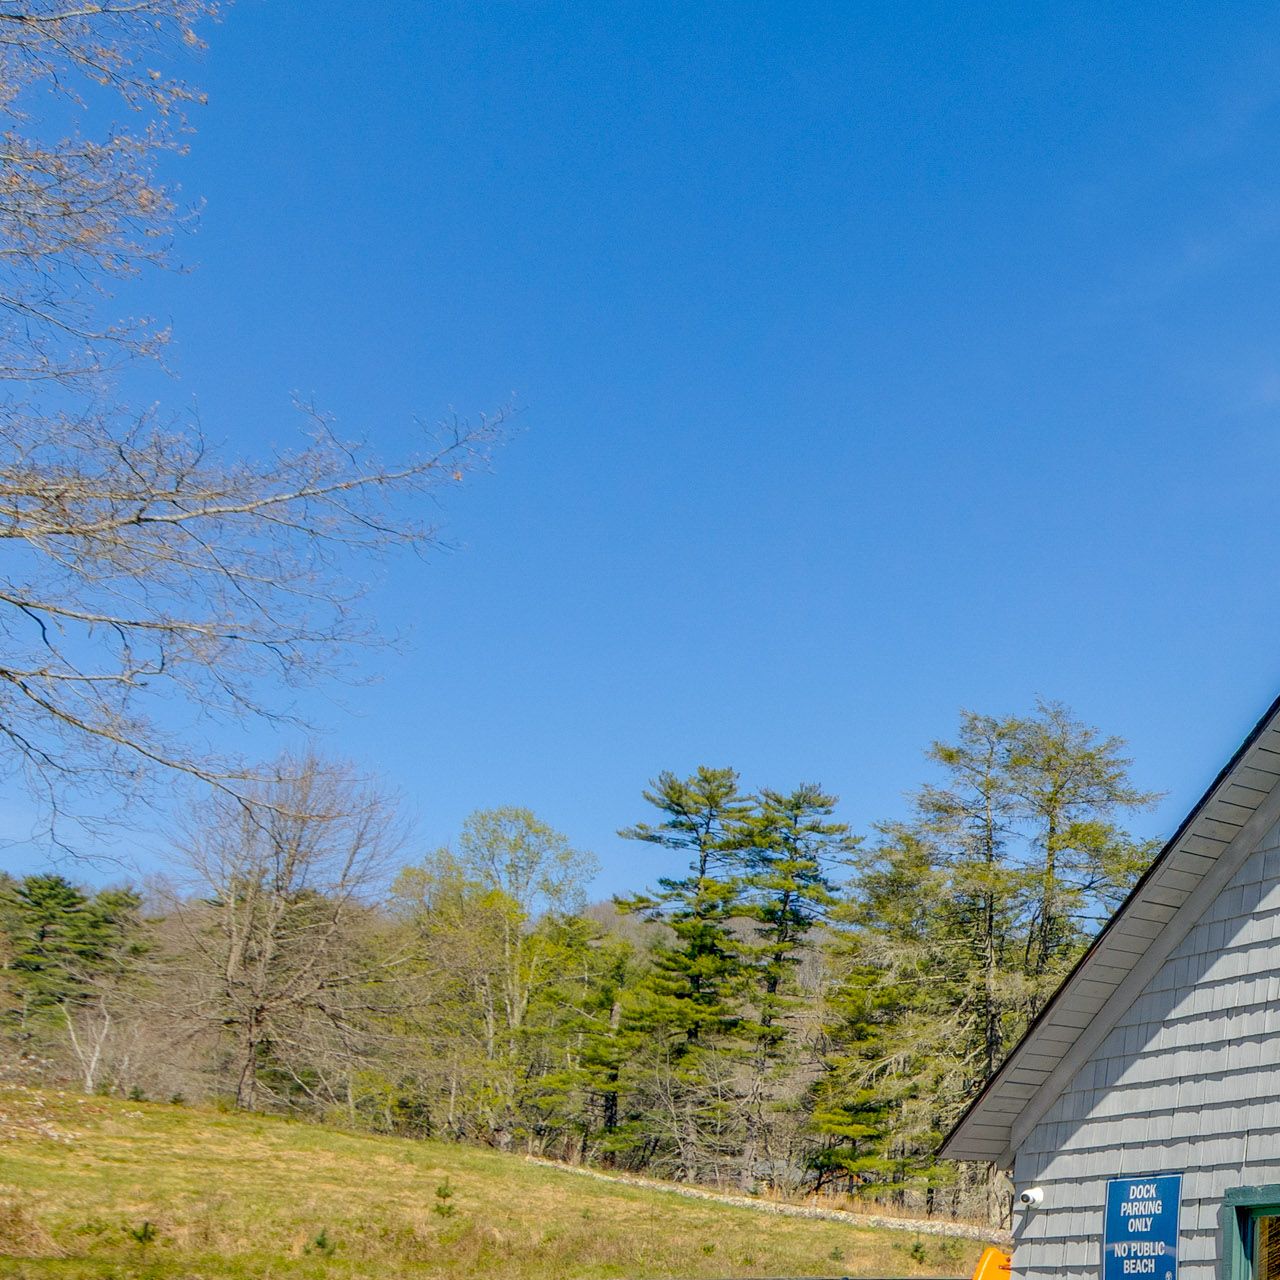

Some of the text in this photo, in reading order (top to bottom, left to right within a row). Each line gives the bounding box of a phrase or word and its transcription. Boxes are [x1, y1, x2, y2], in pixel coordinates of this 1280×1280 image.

[1129, 1184, 1157, 1199] DOCK
[1120, 1200, 1162, 1216] PARKING
[1128, 1217, 1153, 1232] ONLY
[1114, 1241, 1165, 1257] NO PUBLIC
[1123, 1259, 1155, 1274] BEACH
